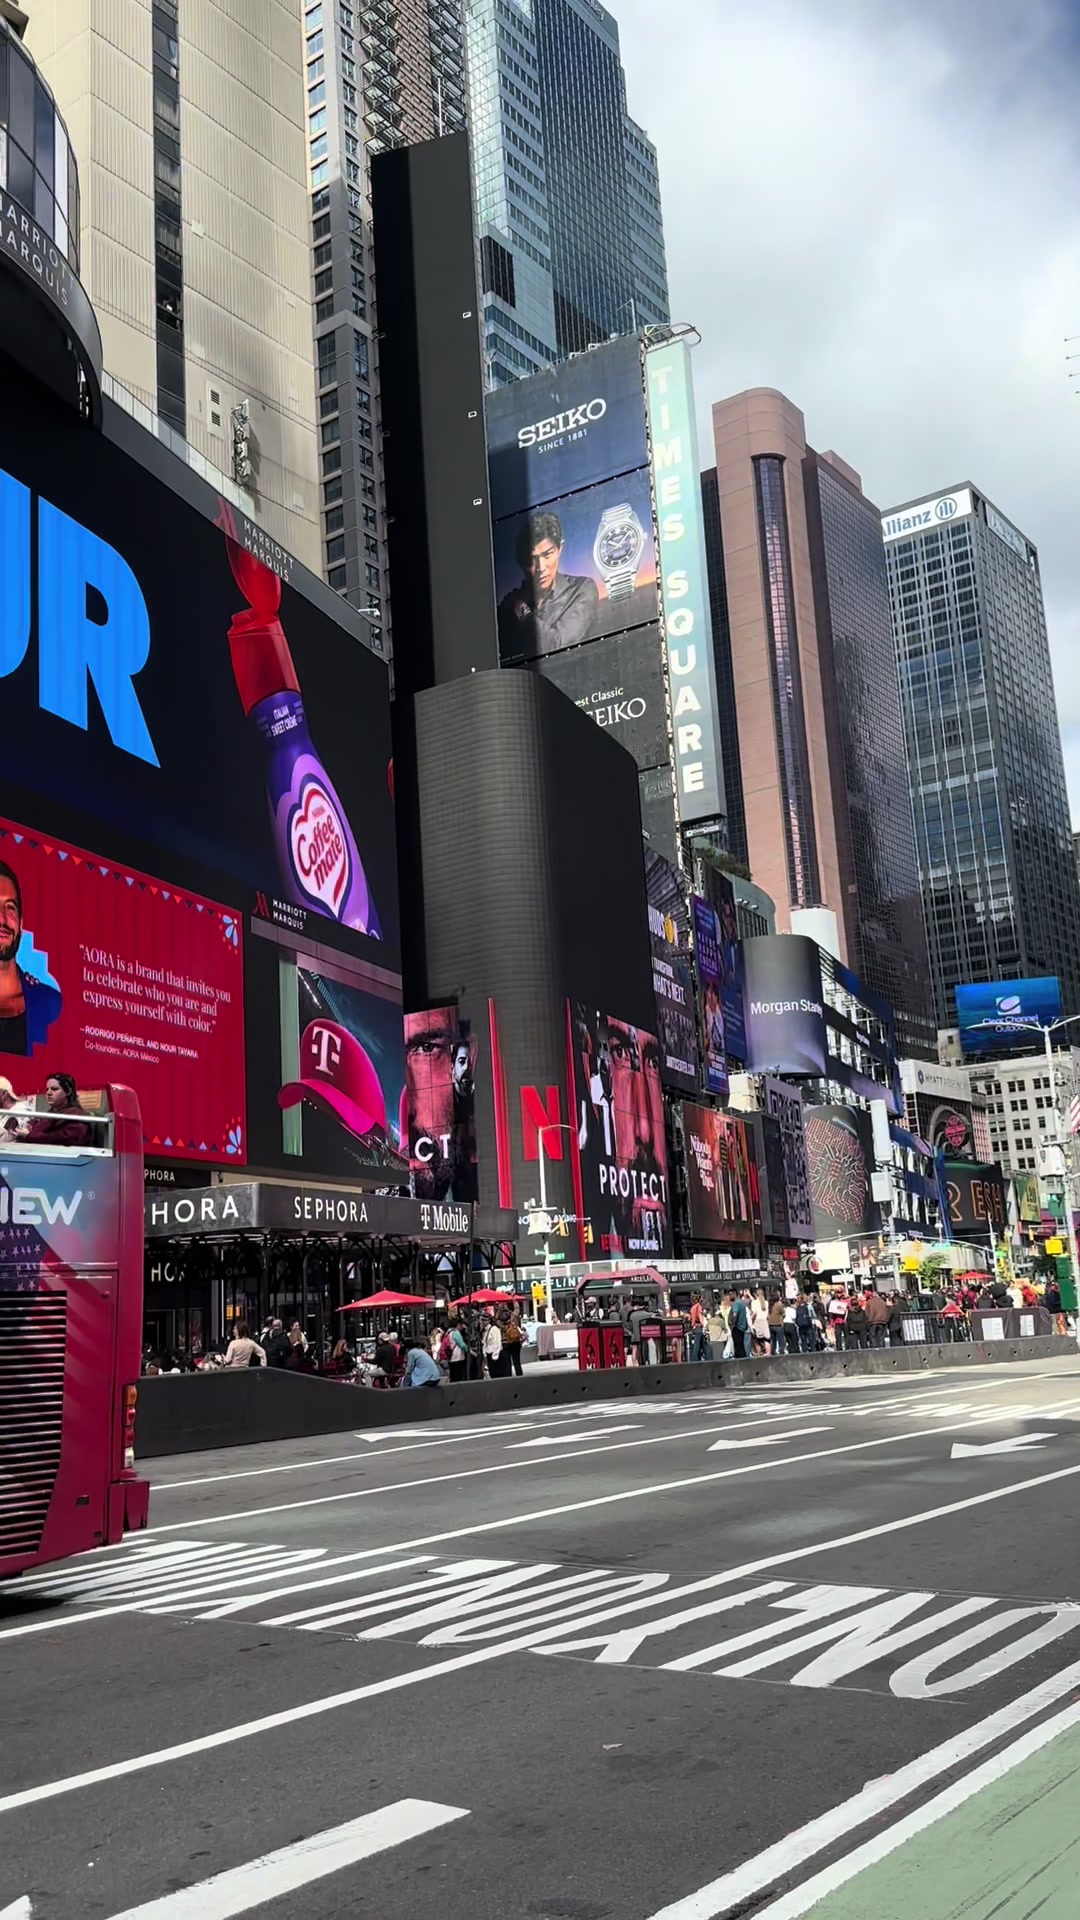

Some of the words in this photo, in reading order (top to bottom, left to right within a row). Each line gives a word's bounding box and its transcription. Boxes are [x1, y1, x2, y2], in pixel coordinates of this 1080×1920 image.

[0, 192, 74, 290] ARRIOTT
[0, 222, 68, 305] ARQUIS
[518, 398, 607, 449] SEIKO
[538, 437, 564, 454] SINCE
[567, 429, 588, 444] 1881
[651, 366, 686, 542] TIMES
[244, 519, 293, 570] MARRIOTT
[244, 536, 289, 581] MARQUIS
[591, 687, 624, 703] Classic
[666, 570, 704, 794] SQUARE
[298, 815, 335, 877] Coffee
[314, 833, 343, 891] mate
[272, 898, 307, 920] MARRIOTT
[272, 910, 304, 930] MARQUIS
[83, 966, 94, 982] to
[96, 971, 143, 996] celebrate
[145, 985, 165, 1001] who
[166, 991, 184, 1007] you
[185, 998, 200, 1012] are
[201, 1001, 218, 1017] and
[116, 955, 126, 972] is
[127, 964, 134, 974] a
[135, 960, 165, 983] brand
[166, 970, 185, 990] that
[186, 976, 215, 998] invites
[215, 988, 232, 1004] you
[83, 989, 124, 1008] express
[124, 999, 164, 1021] yourself
[165, 1009, 187, 1026] with
[750, 1001, 799, 1015] Morgan
[147, 1039, 159, 1050] AND
[520, 1085, 563, 1161] N
[600, 1163, 666, 1202] PROTECT
[143, 1195, 239, 1225] HORA
[294, 1196, 368, 1223] SEPHORA
[432, 1204, 469, 1232] Mobile
